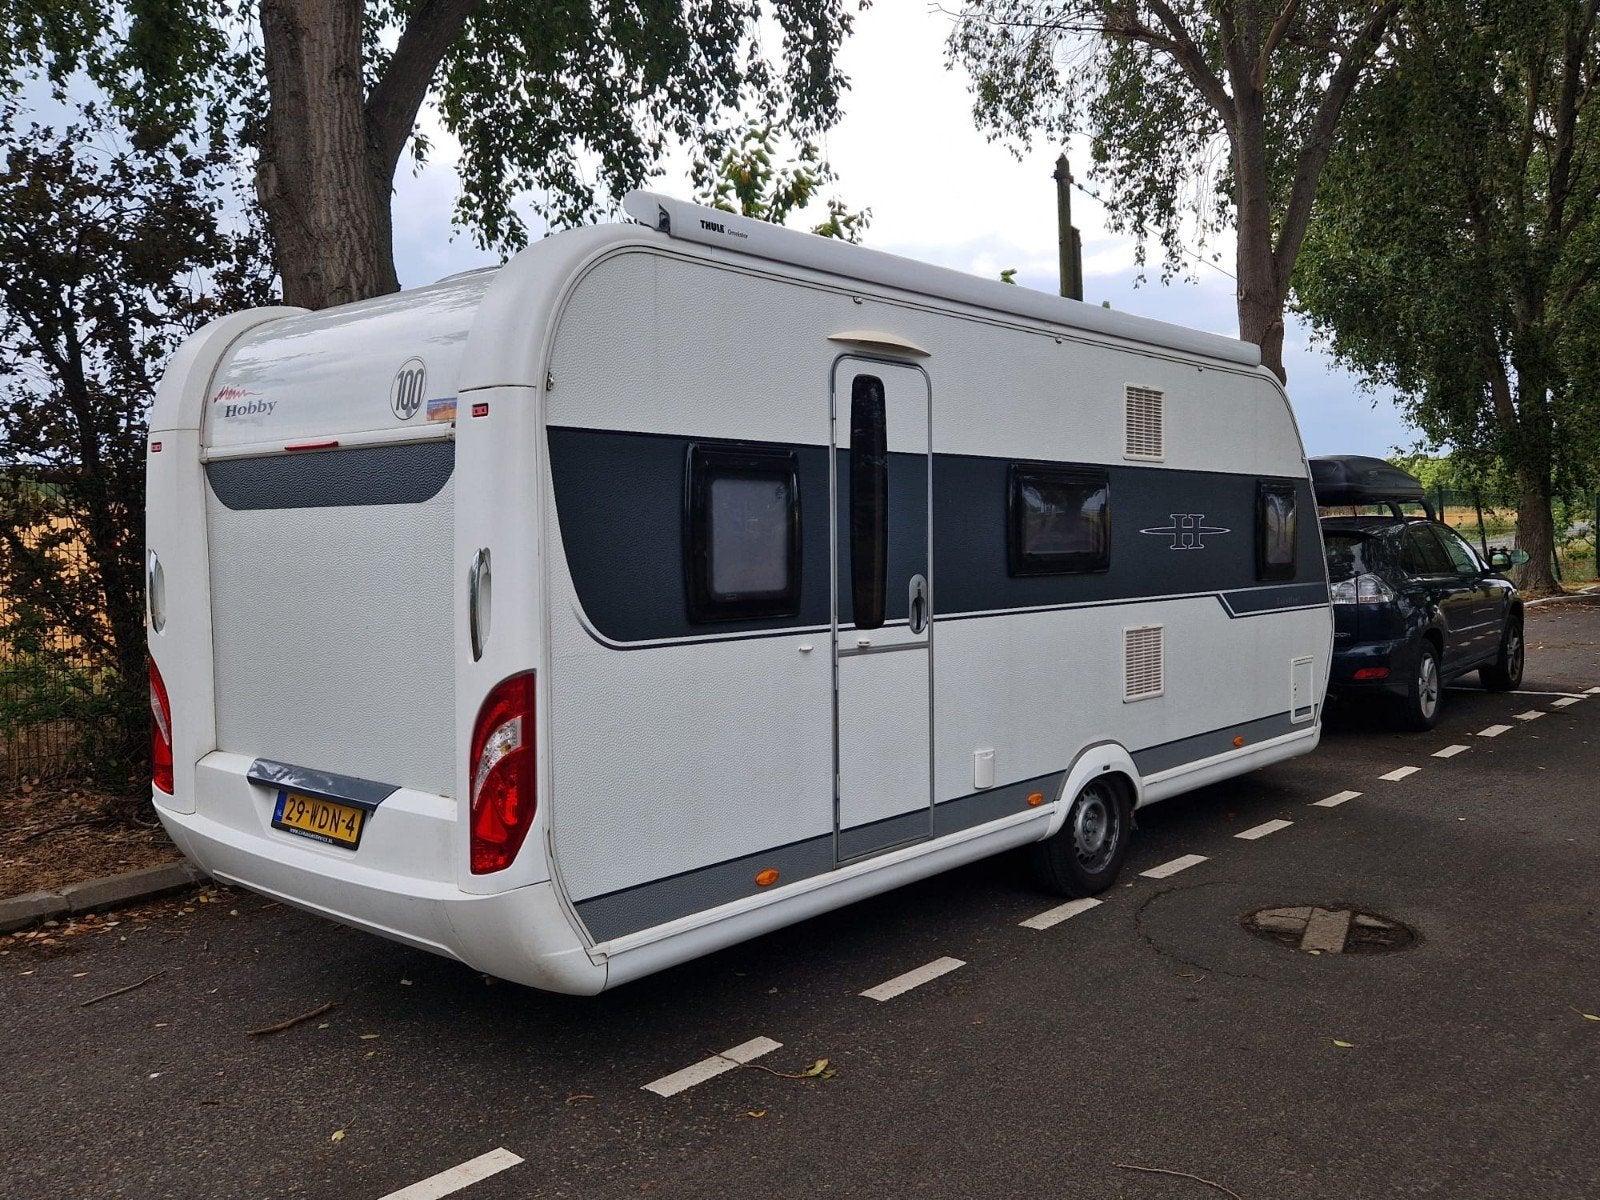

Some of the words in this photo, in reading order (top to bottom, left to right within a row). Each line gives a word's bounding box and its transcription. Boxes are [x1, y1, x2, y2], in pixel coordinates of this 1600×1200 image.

[700, 219, 725, 233] THULE
[396, 368, 425, 411] 100
[224, 400, 278, 418] Hobby
[285, 797, 355, 838] 29-WDN-4
